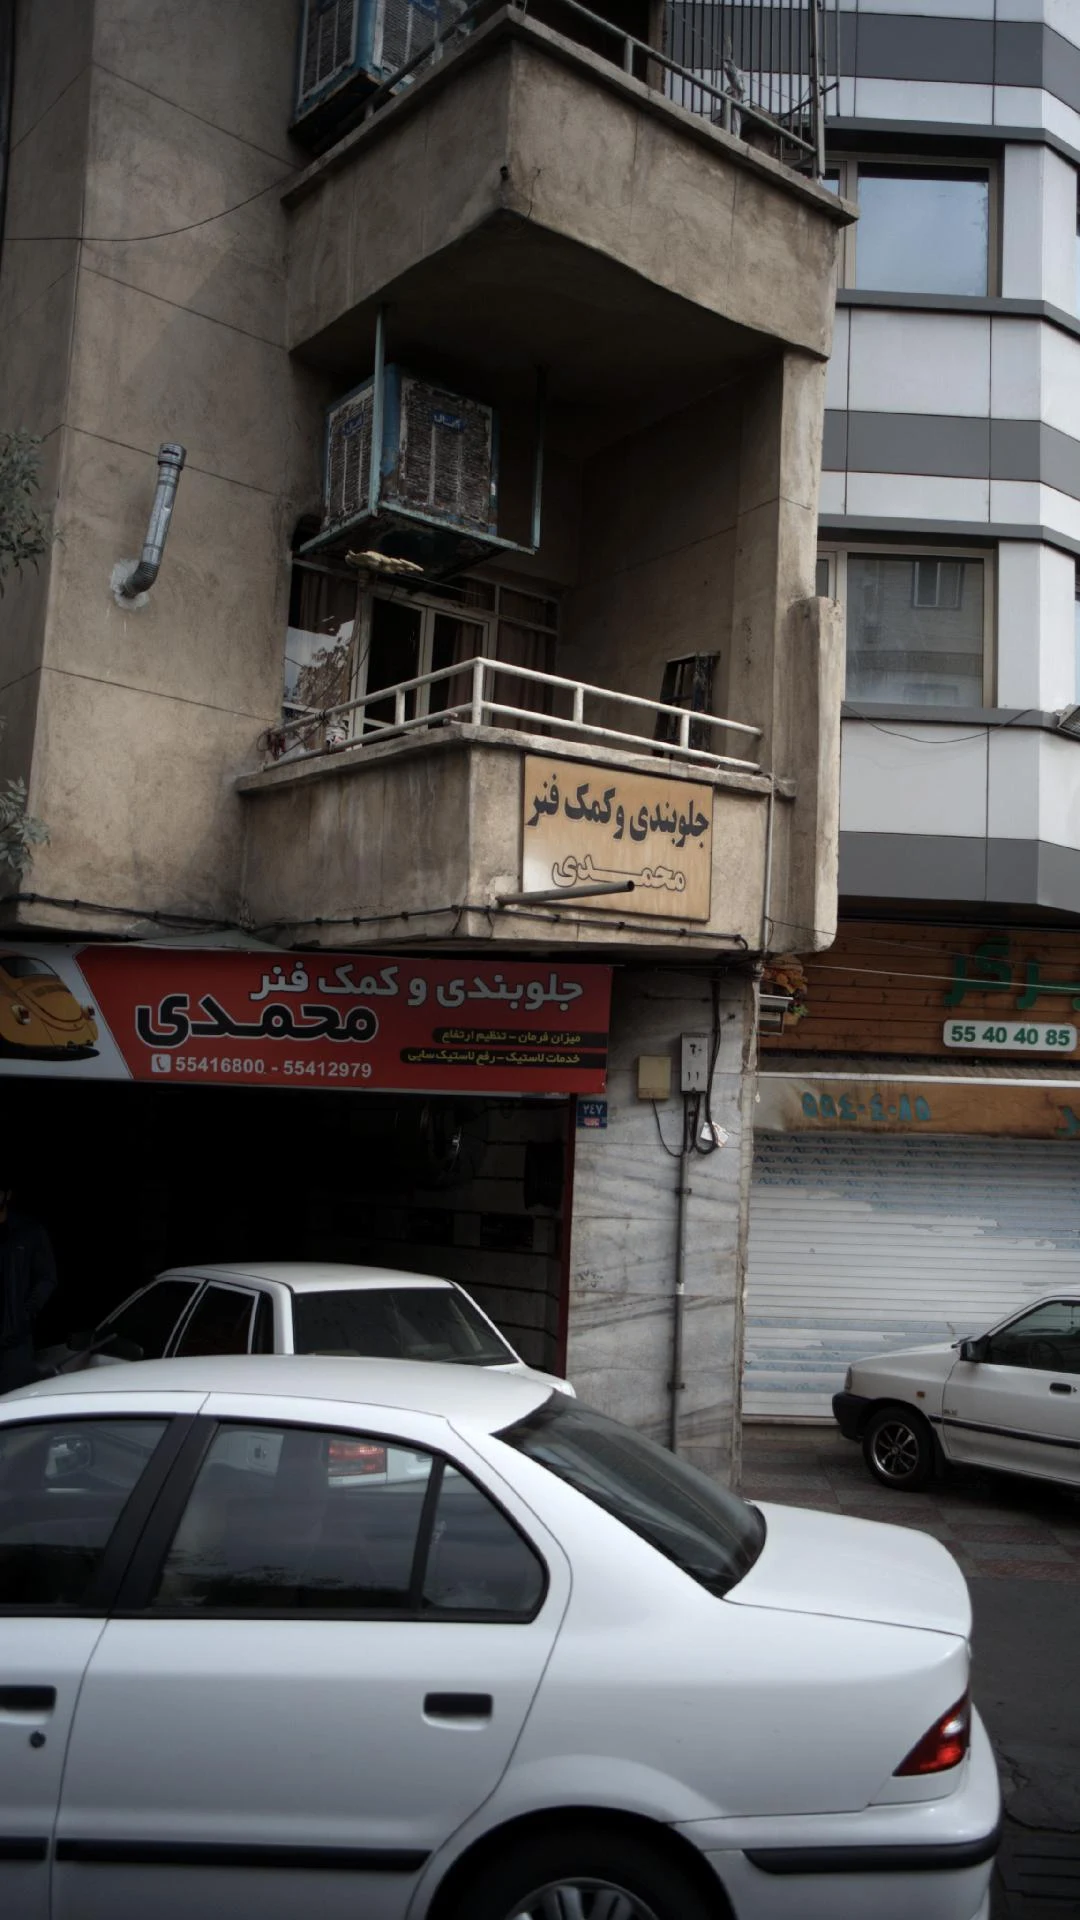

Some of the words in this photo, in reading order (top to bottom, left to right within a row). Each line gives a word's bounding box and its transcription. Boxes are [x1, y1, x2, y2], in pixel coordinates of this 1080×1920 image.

[526, 773, 560, 826] فنر
[564, 783, 616, 825] کمک
[613, 804, 625, 840] و
[629, 799, 710, 849] جلوبندی
[551, 854, 687, 892] محمدی
[249, 960, 309, 1001] فنر
[317, 962, 399, 997] کمک
[407, 976, 427, 1006] و
[435, 972, 584, 1012] جلوبندی
[135, 993, 379, 1049] محمدی
[441, 1028, 474, 1043] ارتفاع
[476, 1030, 506, 1042] تنظیم
[951, 1026, 976, 1042] 55
[982, 1026, 1007, 1043] 40
[1013, 1028, 1039, 1045] 40
[1045, 1029, 1070, 1046] 85
[518, 1031, 549, 1044] فرمان
[551, 1031, 581, 1045] میزان
[175, 1056, 264, 1075] 55416800
[283, 1060, 372, 1078] 55412979
[505, 1051, 544, 1064] لاستیک
[545, 1052, 580, 1064] خدمات
